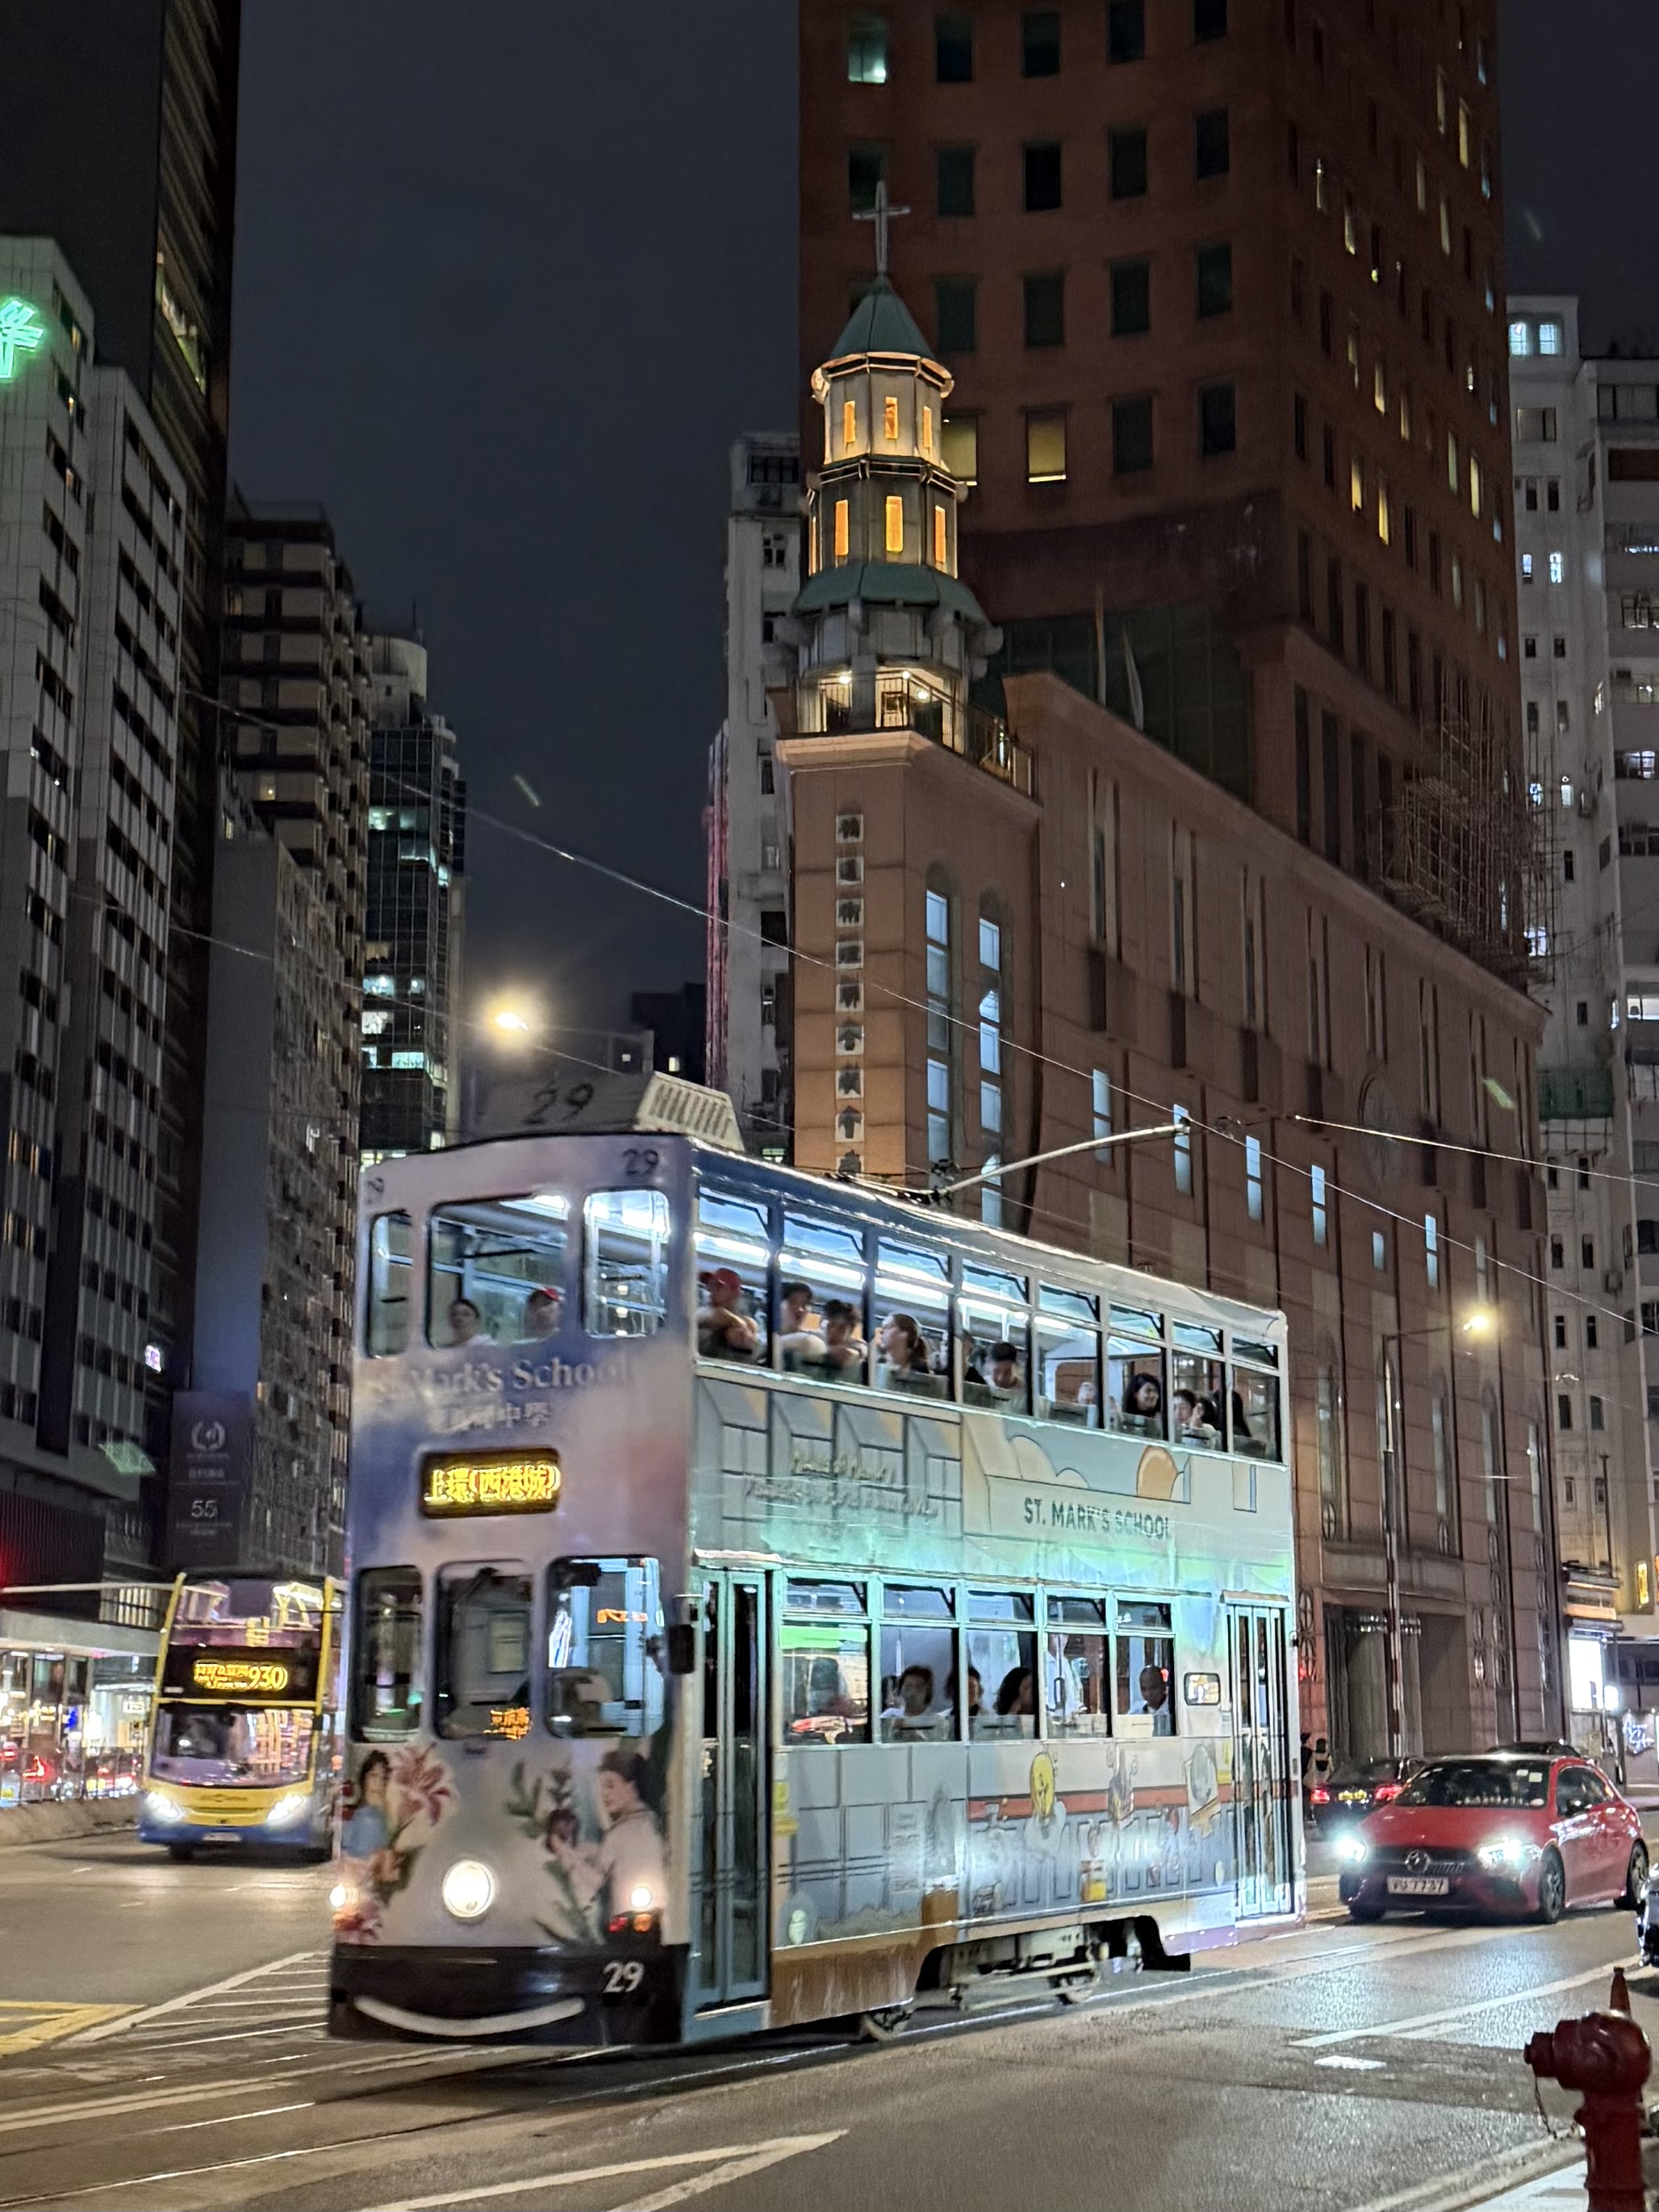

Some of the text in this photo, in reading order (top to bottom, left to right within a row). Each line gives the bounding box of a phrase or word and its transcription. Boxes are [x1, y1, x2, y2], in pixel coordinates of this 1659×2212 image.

[523, 1083, 595, 1126] 29
[622, 1148, 659, 1177] 29
[190, 1499, 219, 1519] 55
[1023, 1495, 1172, 1541] ST. MARK'S SCHOOL
[248, 1664, 286, 1691] 930
[601, 1959, 645, 1993] 29
